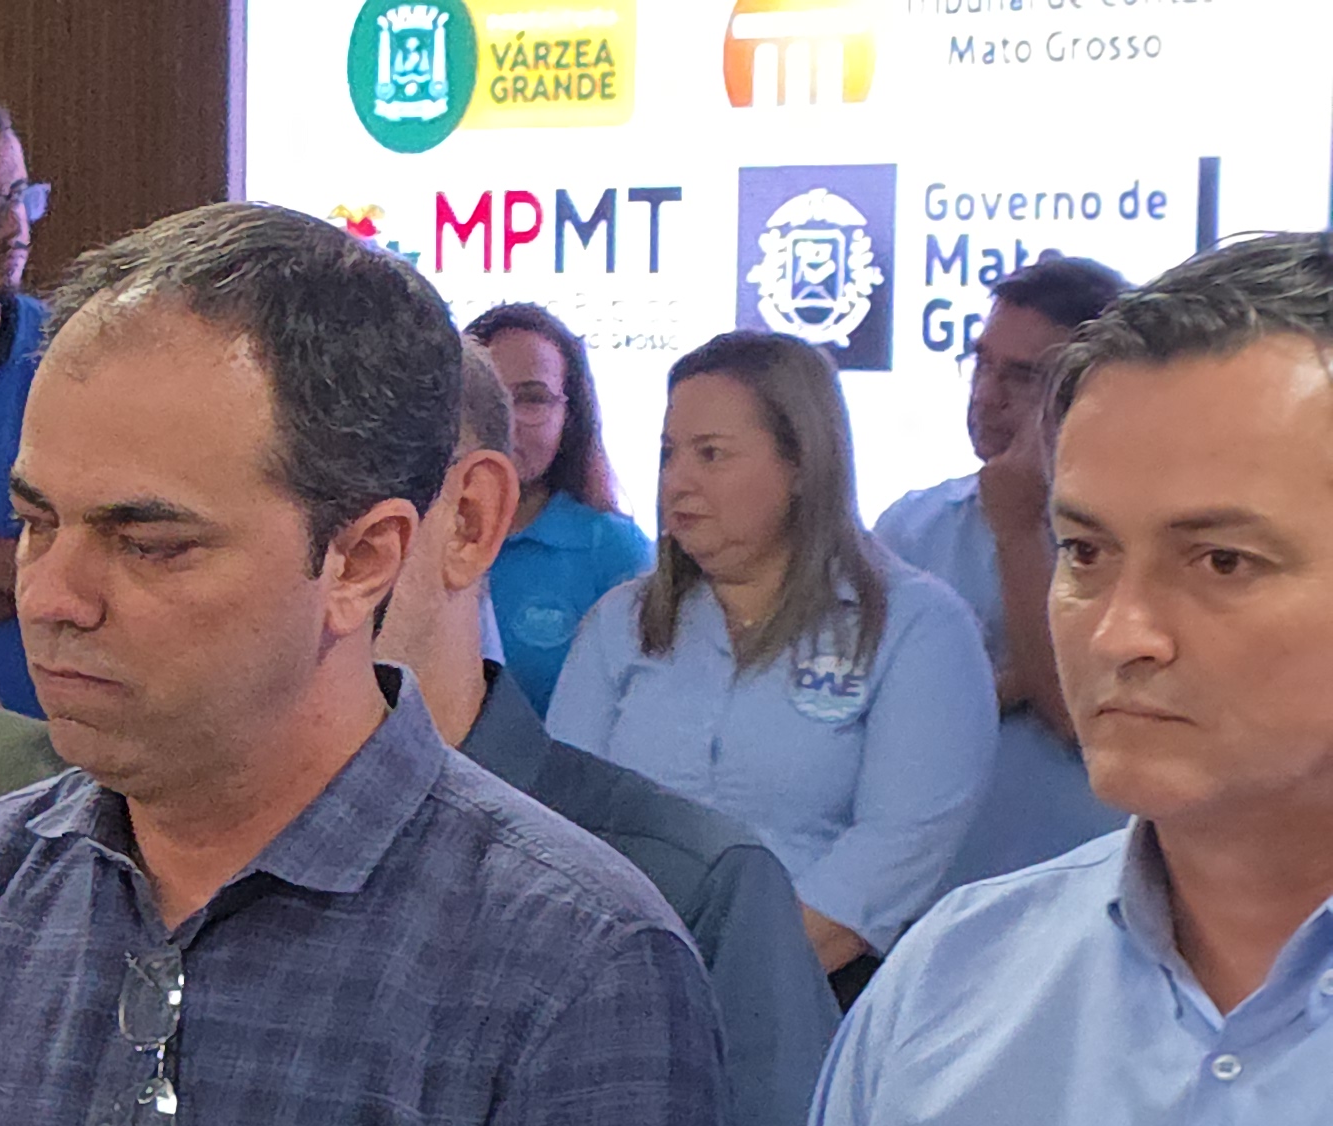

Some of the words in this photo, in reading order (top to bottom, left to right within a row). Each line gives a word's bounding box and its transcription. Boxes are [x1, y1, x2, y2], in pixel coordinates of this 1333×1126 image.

[490, 31, 615, 72] VÁRZEA
[949, 34, 1032, 65] Mato
[1046, 31, 1162, 61] Grosso
[490, 71, 617, 104] GRANDE
[924, 183, 1102, 221] Governo
[1118, 179, 1168, 220] de
[434, 186, 683, 274] MPMT
